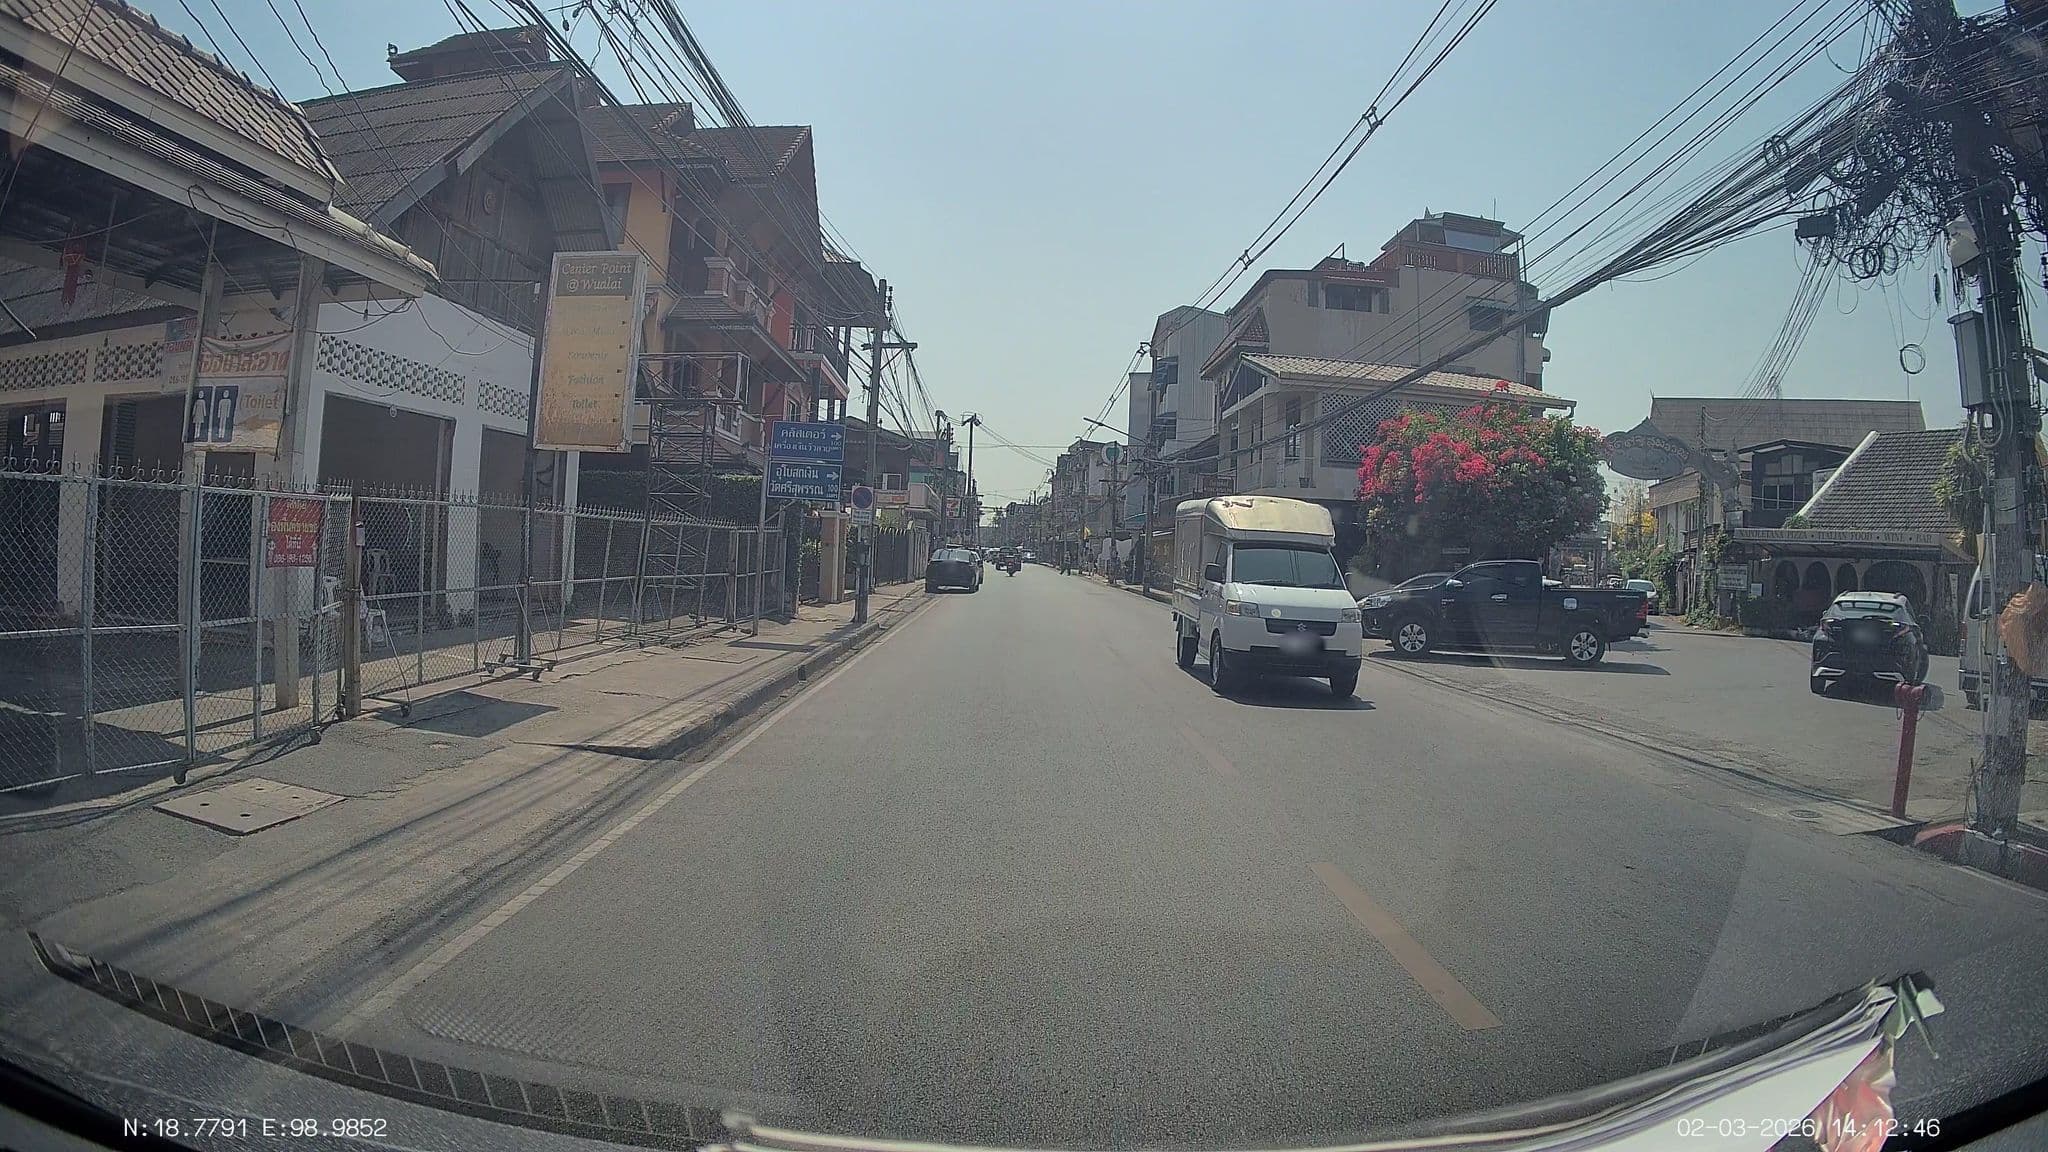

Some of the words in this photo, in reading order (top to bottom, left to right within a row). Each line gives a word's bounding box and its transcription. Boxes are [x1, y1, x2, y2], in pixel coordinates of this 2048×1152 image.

[562, 264, 597, 275] Center
[602, 262, 632, 274] Point
[567, 278, 579, 293] @
[581, 276, 623, 291] Wualai
[769, 480, 824, 496] วัดศรีสุพรรณ
[1785, 530, 1808, 539] PIZZA
[1818, 531, 1848, 540] ITALIAN
[1850, 531, 1873, 540] FOOD
[1884, 532, 1902, 541] WINE
[1916, 534, 1933, 542] BAR
